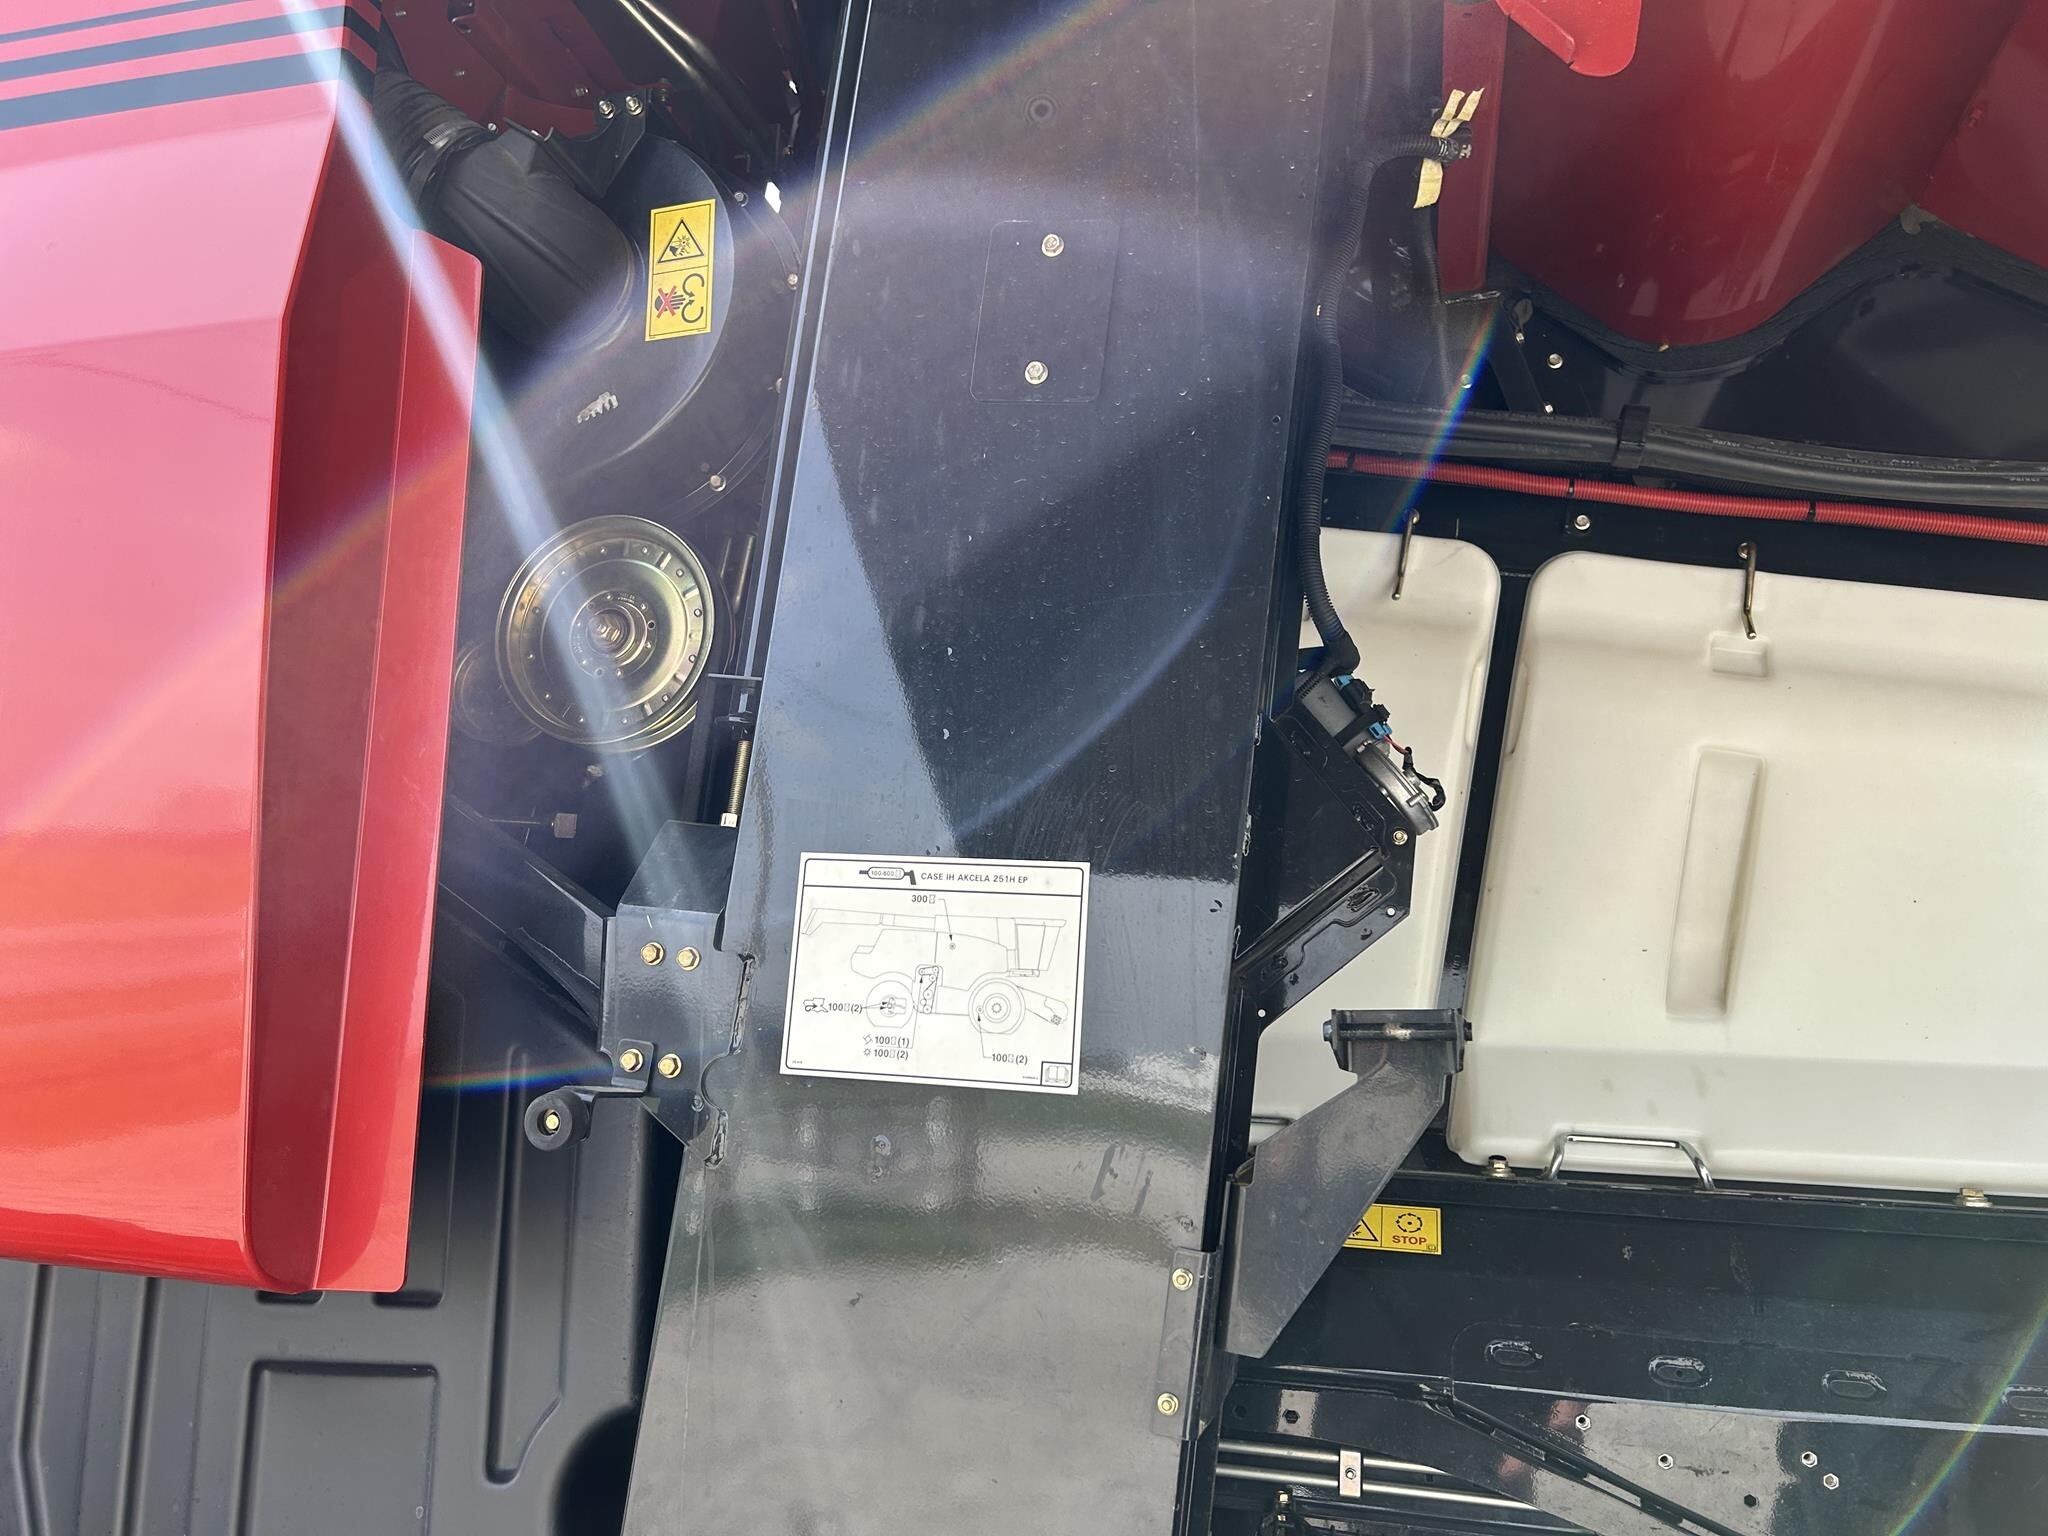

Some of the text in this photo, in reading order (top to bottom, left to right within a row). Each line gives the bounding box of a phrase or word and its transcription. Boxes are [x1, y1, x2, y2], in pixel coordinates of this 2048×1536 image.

[921, 872, 1028, 884] CASE IH AKCELA 251H EP
[911, 894, 928, 904] 300
[828, 1002, 863, 1014] 100 (2)
[874, 1036, 910, 1048] 100 (1)
[873, 1049, 909, 1061] 100 (2)
[991, 1053, 1028, 1066] 100 (2)
[1392, 1234, 1427, 1245] STOP
